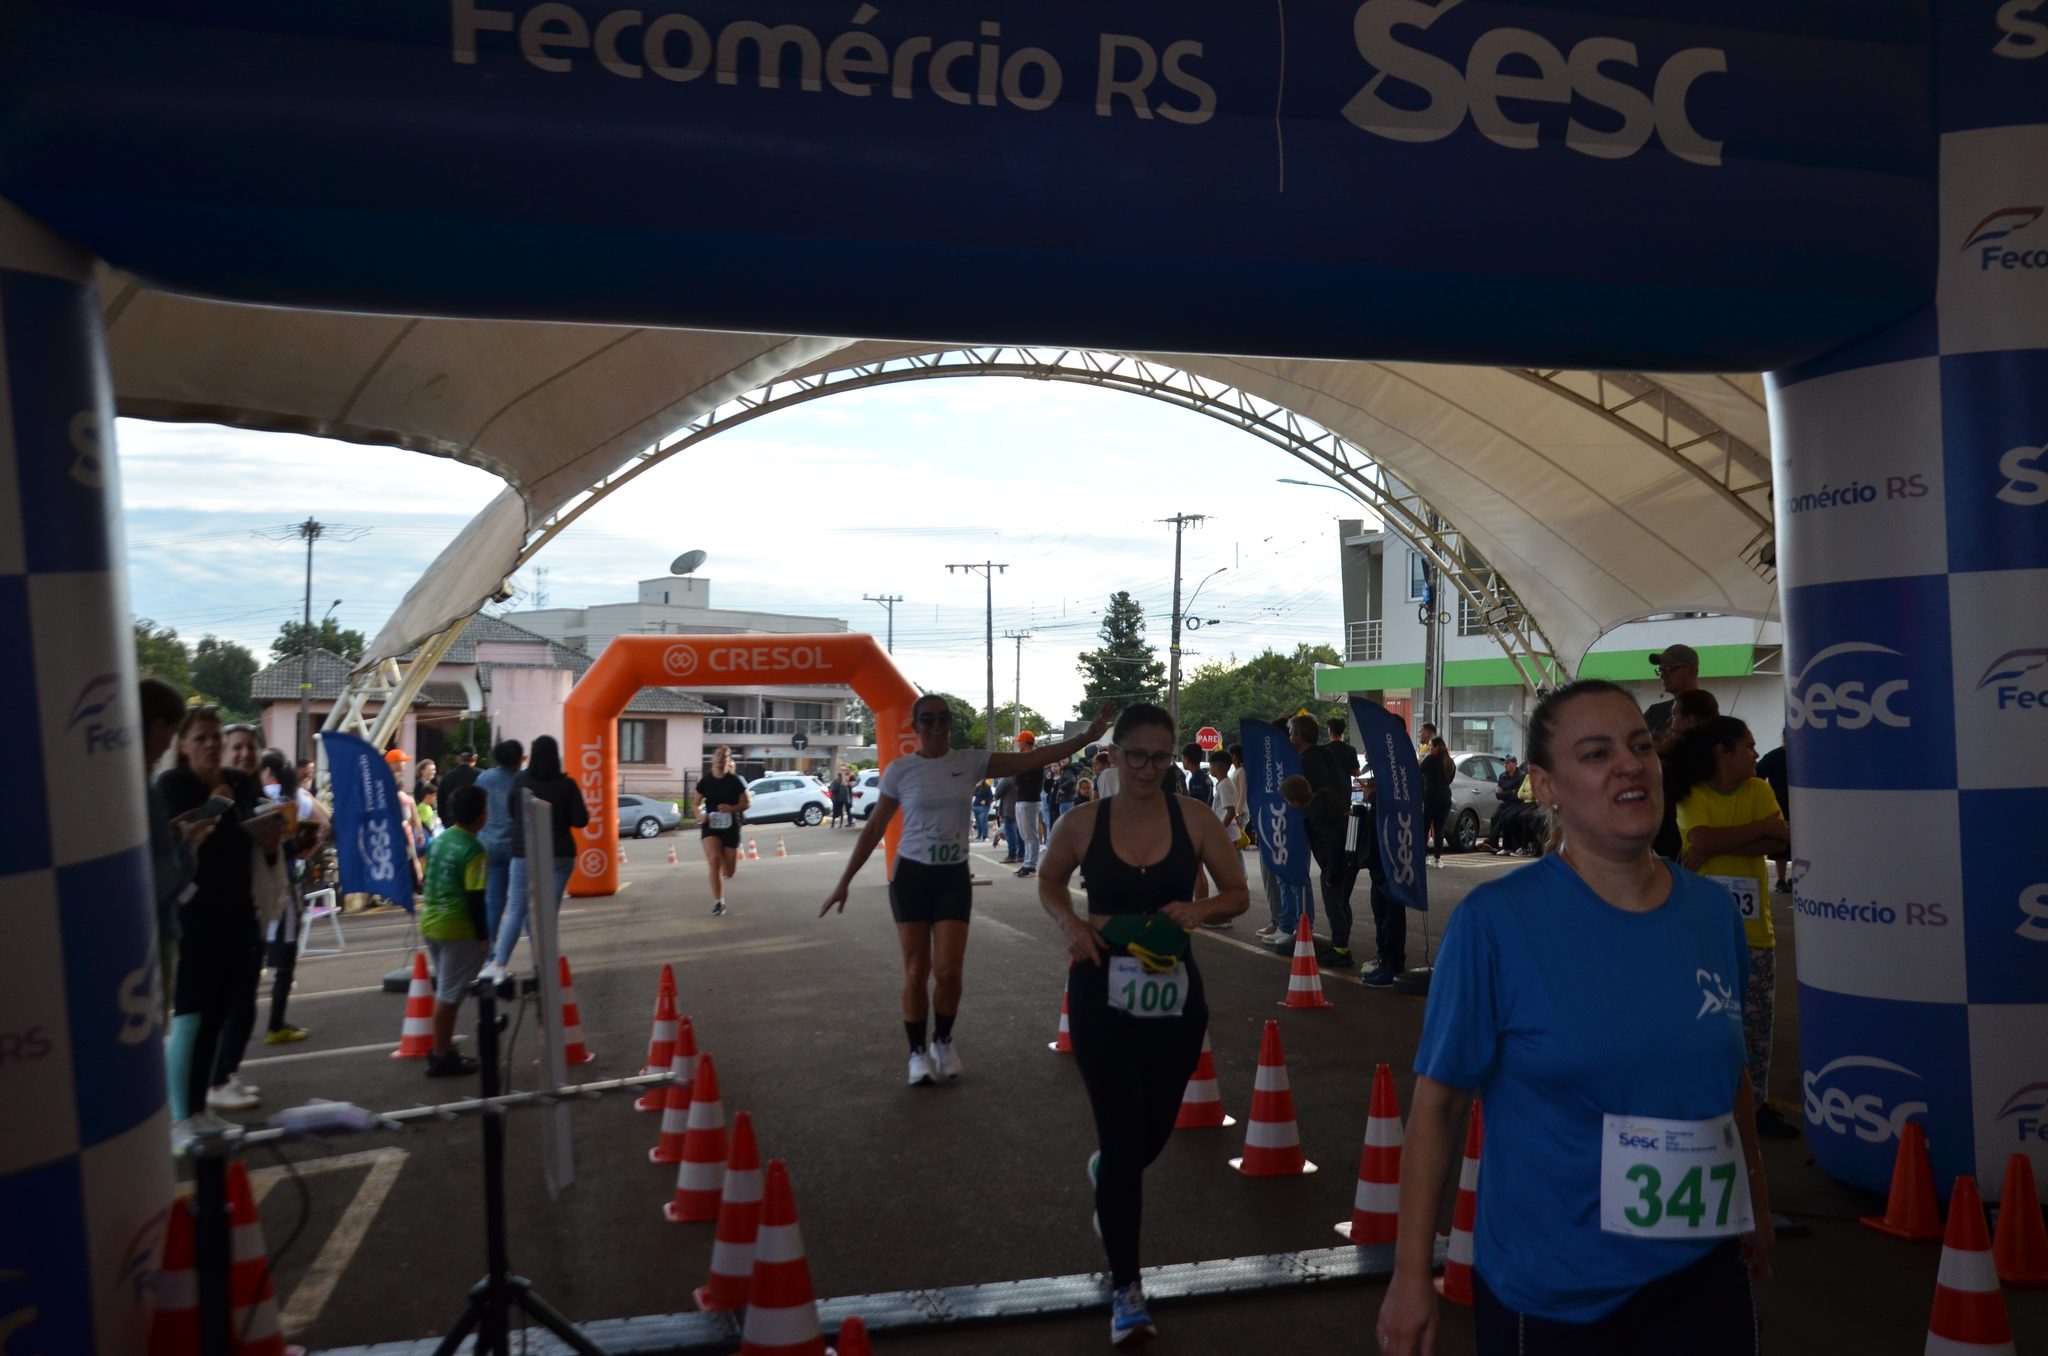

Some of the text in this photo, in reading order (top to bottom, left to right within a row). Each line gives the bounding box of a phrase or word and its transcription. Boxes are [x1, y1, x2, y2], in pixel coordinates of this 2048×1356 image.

[450, 0, 1217, 125] Fecomércio RS
[1886, 473, 1929, 500] RS
[707, 646, 832, 673] CRESOL
[1197, 734, 1218, 743] PARE
[580, 734, 605, 842] CRESOL
[927, 843, 961, 862] 102
[1905, 902, 1949, 927] RS
[1121, 978, 1178, 1012] 100
[1623, 1160, 1737, 1228] 347
